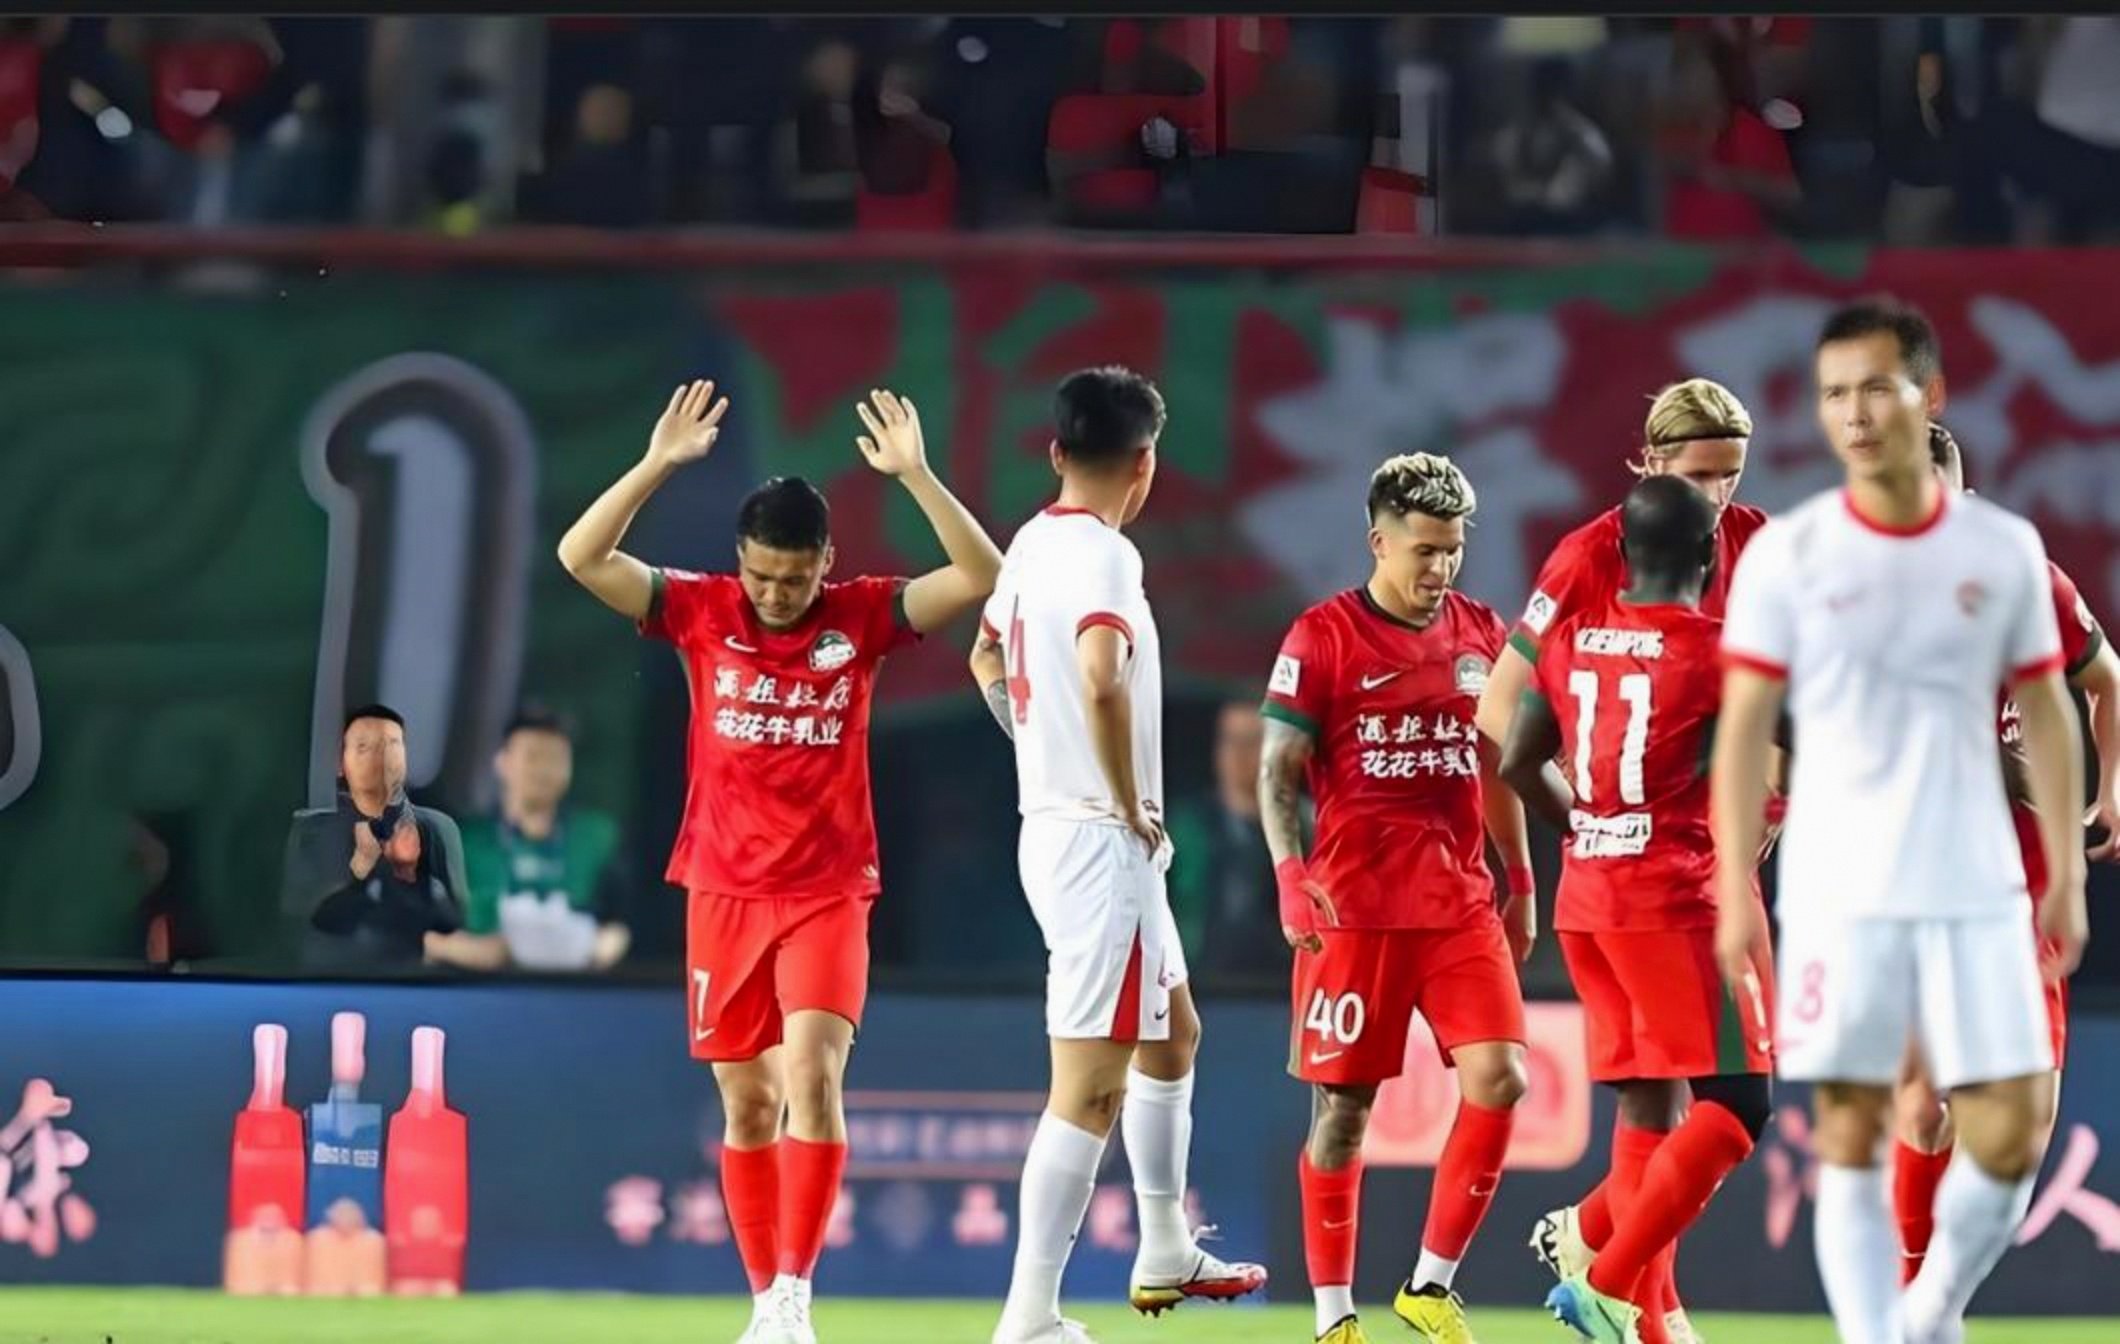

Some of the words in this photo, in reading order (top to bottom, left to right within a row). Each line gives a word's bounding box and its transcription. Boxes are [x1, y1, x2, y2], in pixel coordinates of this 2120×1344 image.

[1568, 670, 1653, 806] 11
[692, 967, 712, 1026] 7
[1305, 988, 1366, 1045] 40
